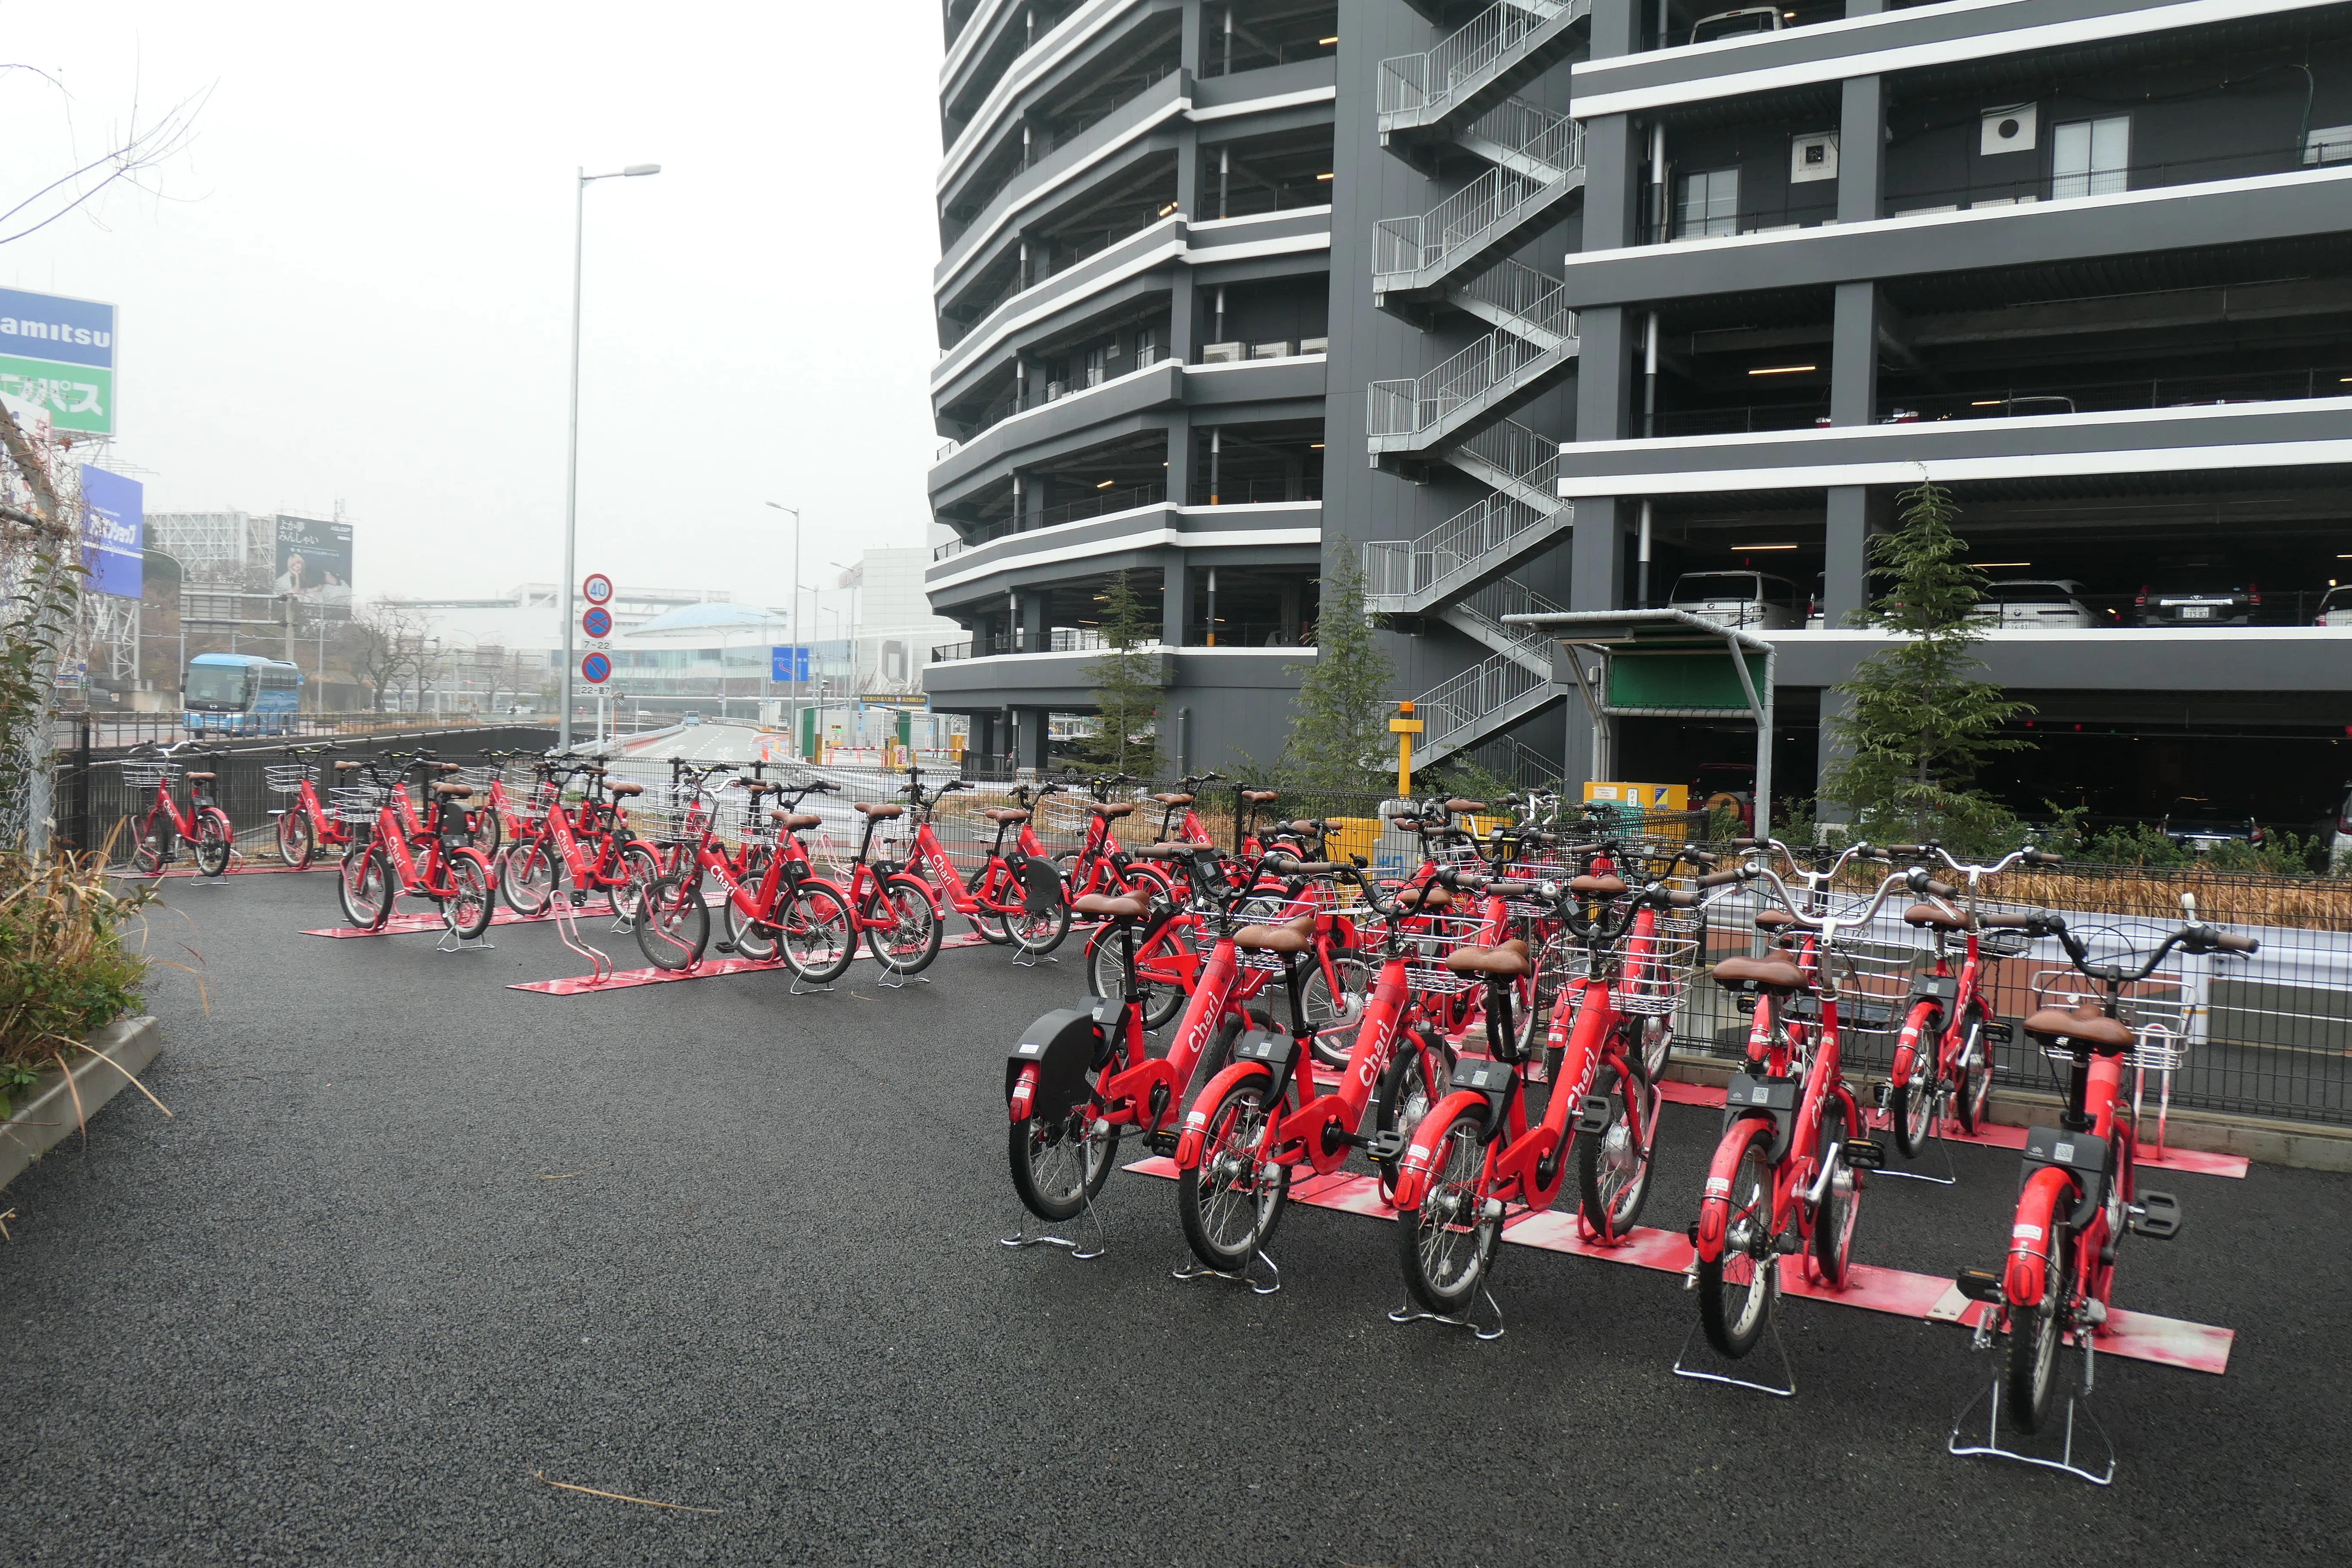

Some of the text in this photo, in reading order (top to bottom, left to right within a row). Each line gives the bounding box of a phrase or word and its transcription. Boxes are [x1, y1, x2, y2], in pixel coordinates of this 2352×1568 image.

[279, 530, 319, 544] みんしゃい
[590, 583, 606, 597] 40
[584, 641, 610, 649] 7-22
[163, 799, 177, 821] Chari
[306, 798, 318, 821] Chari
[389, 836, 406, 868] Chari
[558, 830, 575, 858] Chari
[710, 865, 738, 897] Chari
[933, 854, 955, 886] Chari
[1957, 980, 1972, 1026] Chari
[1188, 991, 1219, 1053] Chari
[1359, 1019, 1390, 1087] Chari
[1567, 1047, 1595, 1112] Chari
[1812, 1061, 1832, 1130] Chari
